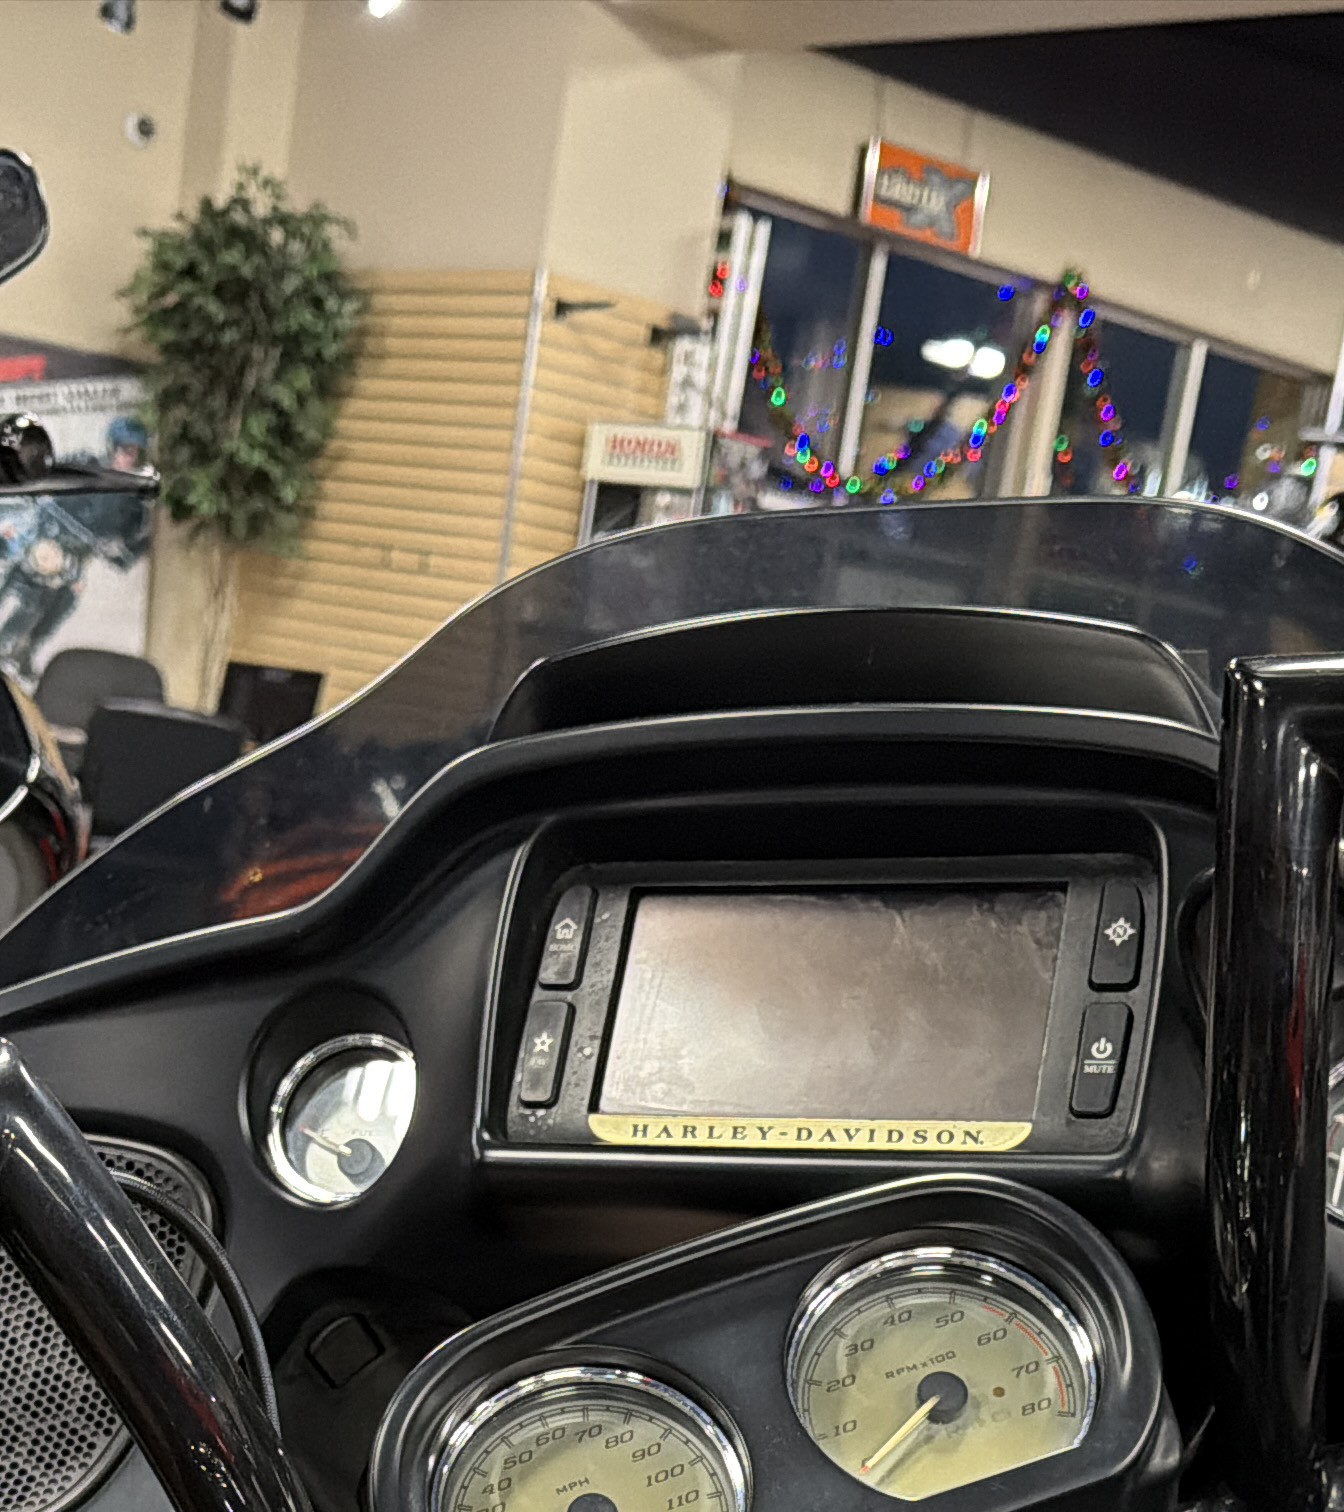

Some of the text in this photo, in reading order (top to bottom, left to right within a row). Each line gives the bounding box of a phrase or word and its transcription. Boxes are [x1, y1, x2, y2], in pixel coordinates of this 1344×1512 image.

[1083, 1064, 1116, 1074] MUTE
[882, 1309, 913, 1327] 40
[935, 1310, 965, 1329] 50
[977, 1328, 1008, 1347] 60
[845, 1338, 875, 1358] 30
[1011, 1361, 1040, 1379] 70
[826, 1374, 856, 1393] 20
[1021, 1398, 1052, 1417] 80
[535, 1427, 566, 1447] 60
[575, 1424, 603, 1444] 70
[833, 1420, 857, 1438] 10
[605, 1430, 634, 1450] 80
[503, 1450, 533, 1470] 50
[631, 1442, 662, 1463] 90
[646, 1464, 685, 1487] 100
[482, 1477, 512, 1496] 40
[556, 1477, 590, 1496] MPH
[667, 1489, 700, 1511] 110
